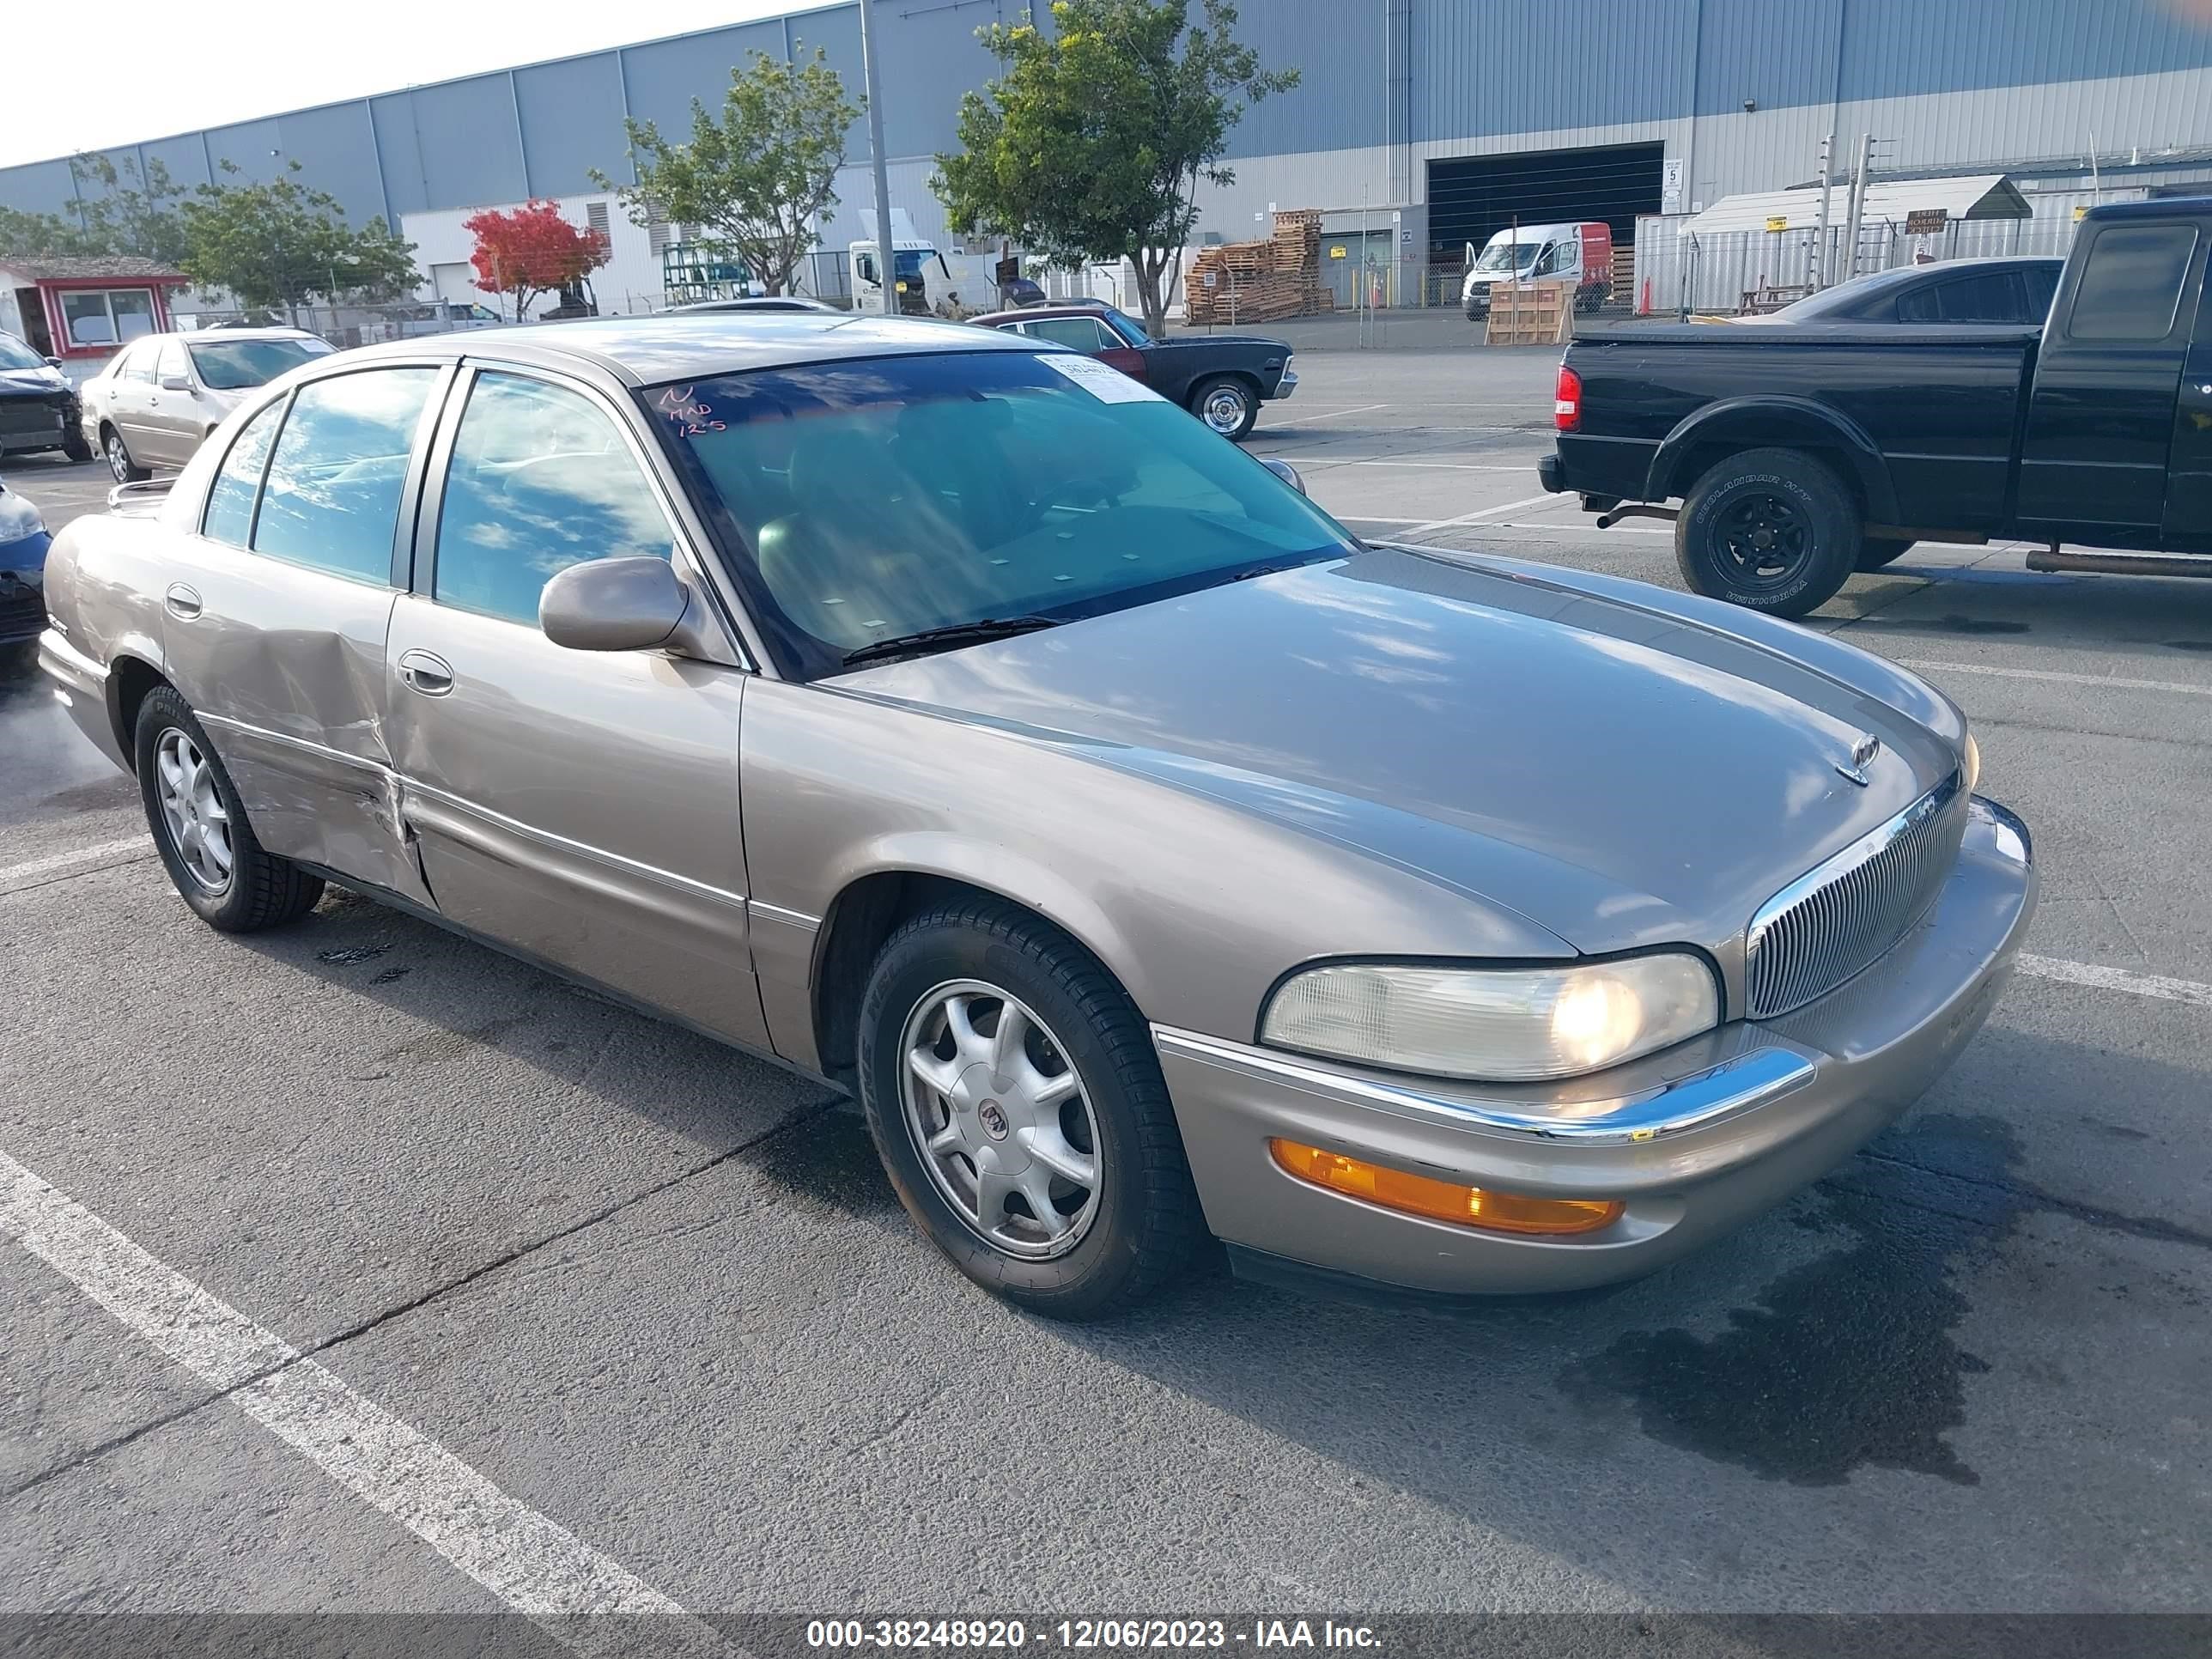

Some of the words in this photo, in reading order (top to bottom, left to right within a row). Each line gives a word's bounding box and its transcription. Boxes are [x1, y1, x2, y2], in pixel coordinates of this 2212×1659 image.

[1669, 169, 1676, 181] 5
[1696, 474, 1780, 524] GEOLANDAR
[1725, 579, 1808, 605] YOKOHAMA
